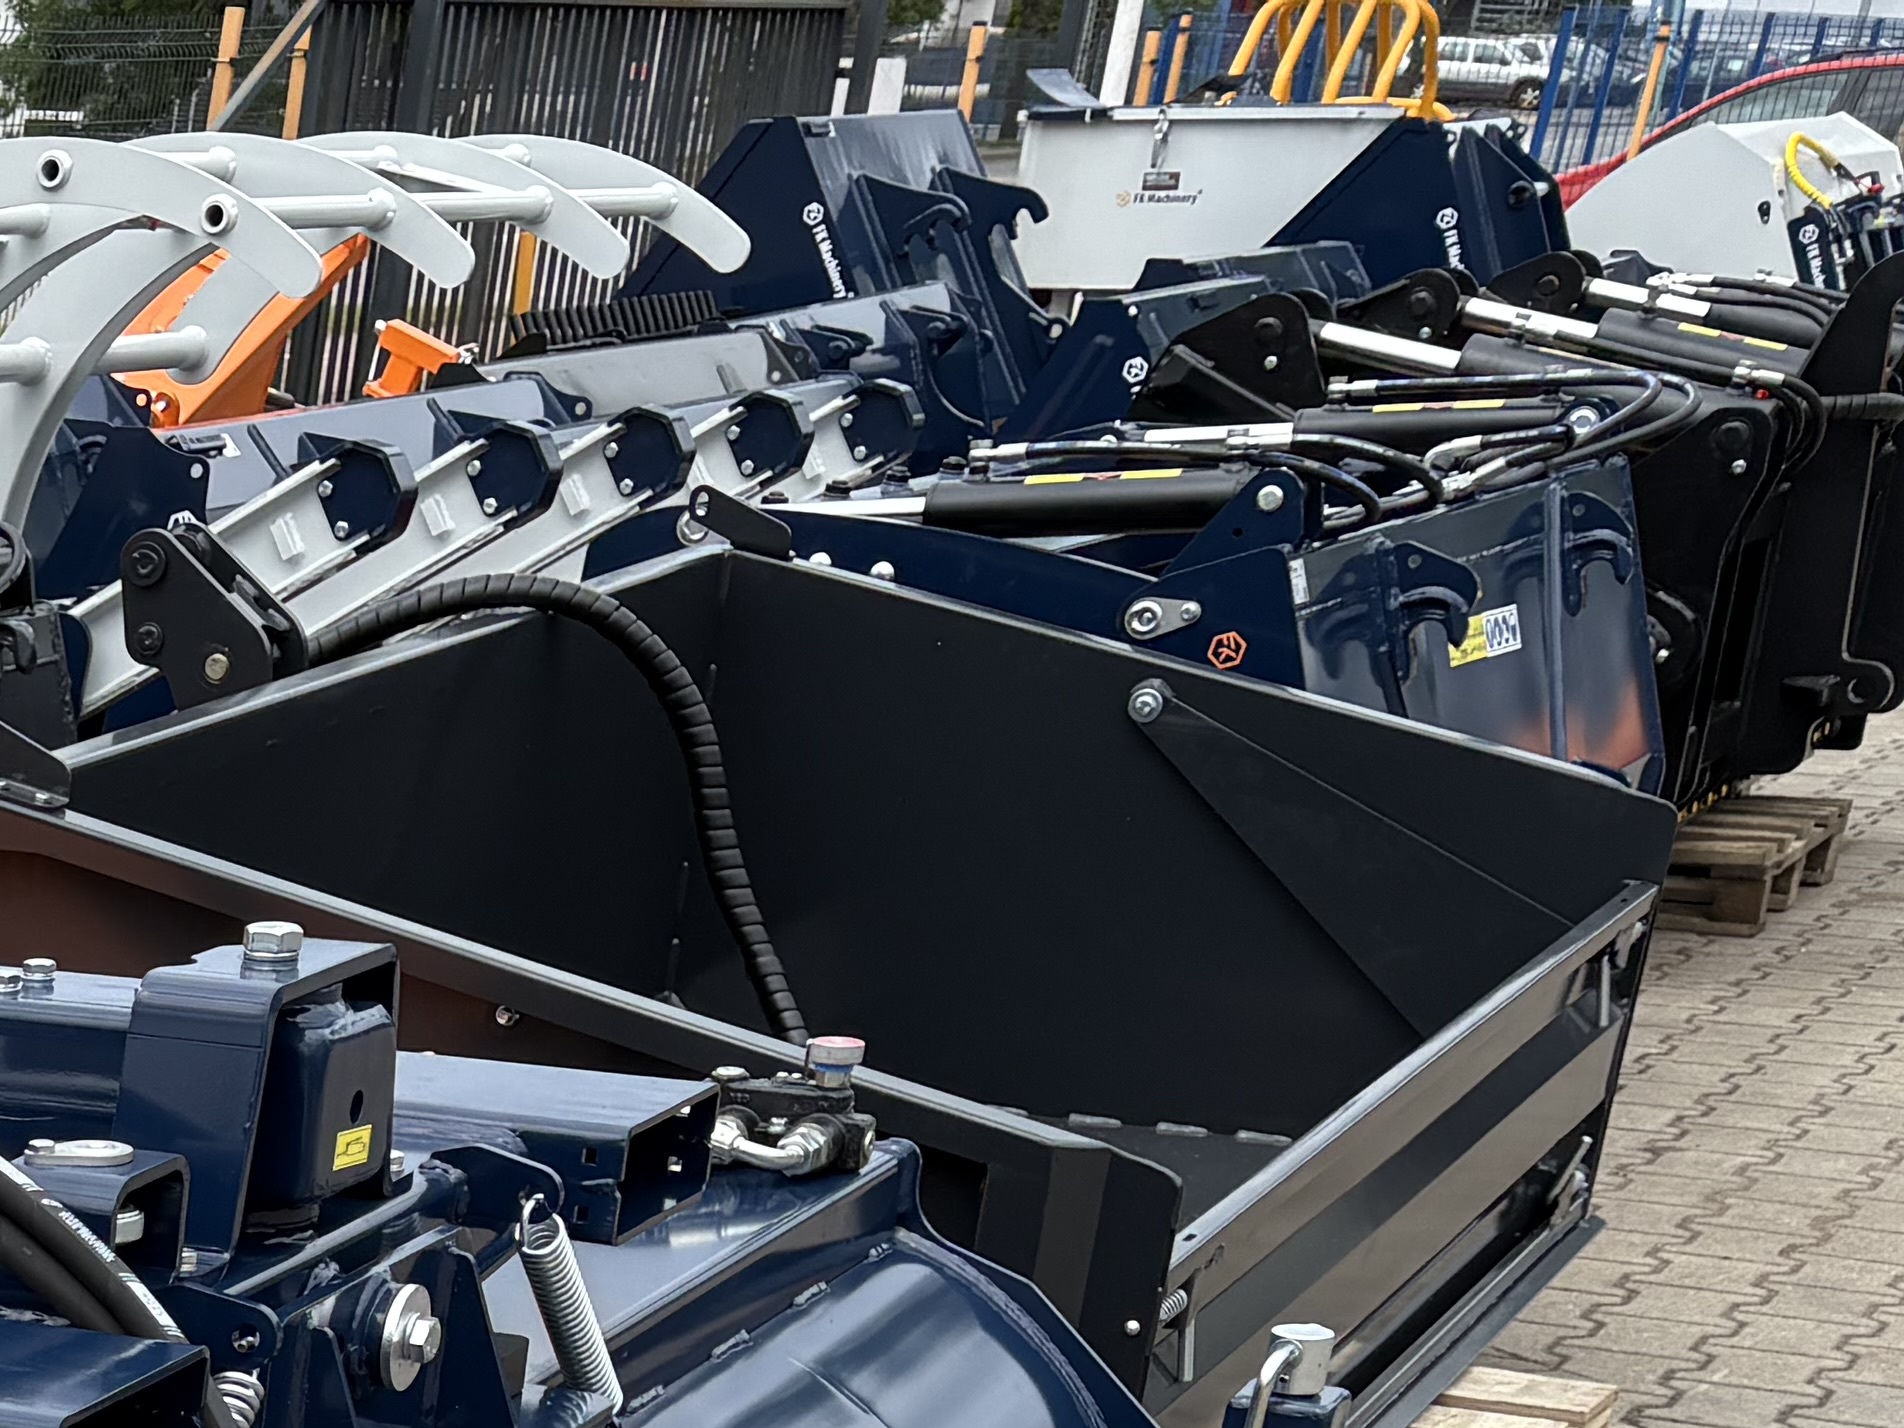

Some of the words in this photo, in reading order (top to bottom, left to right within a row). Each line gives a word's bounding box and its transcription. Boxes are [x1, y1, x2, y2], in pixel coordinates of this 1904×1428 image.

[812, 223, 829, 243] FK
[1442, 228, 1459, 247] FK
[817, 239, 847, 299] Machinery
